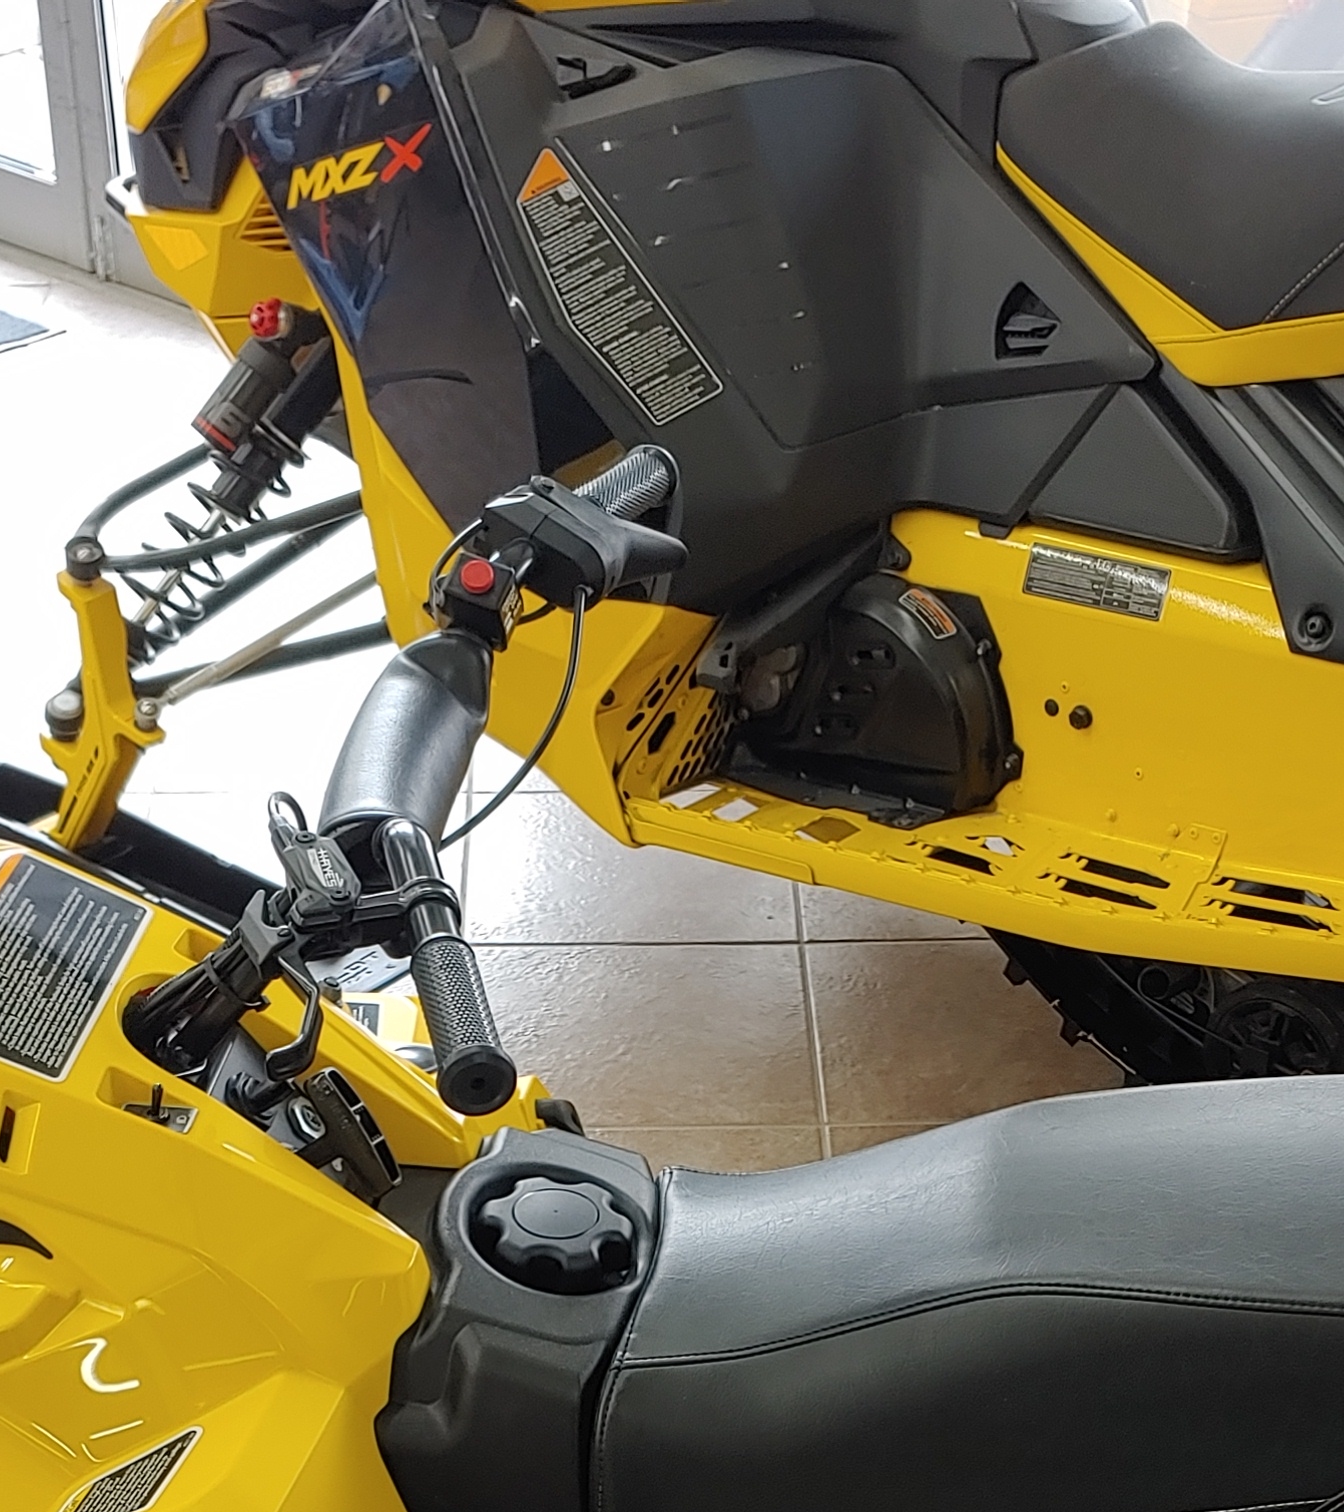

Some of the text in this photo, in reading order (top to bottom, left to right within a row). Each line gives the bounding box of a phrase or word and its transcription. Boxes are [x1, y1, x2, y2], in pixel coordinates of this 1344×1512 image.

[287, 122, 432, 210] MXZ X
[317, 847, 337, 887] HAYES
